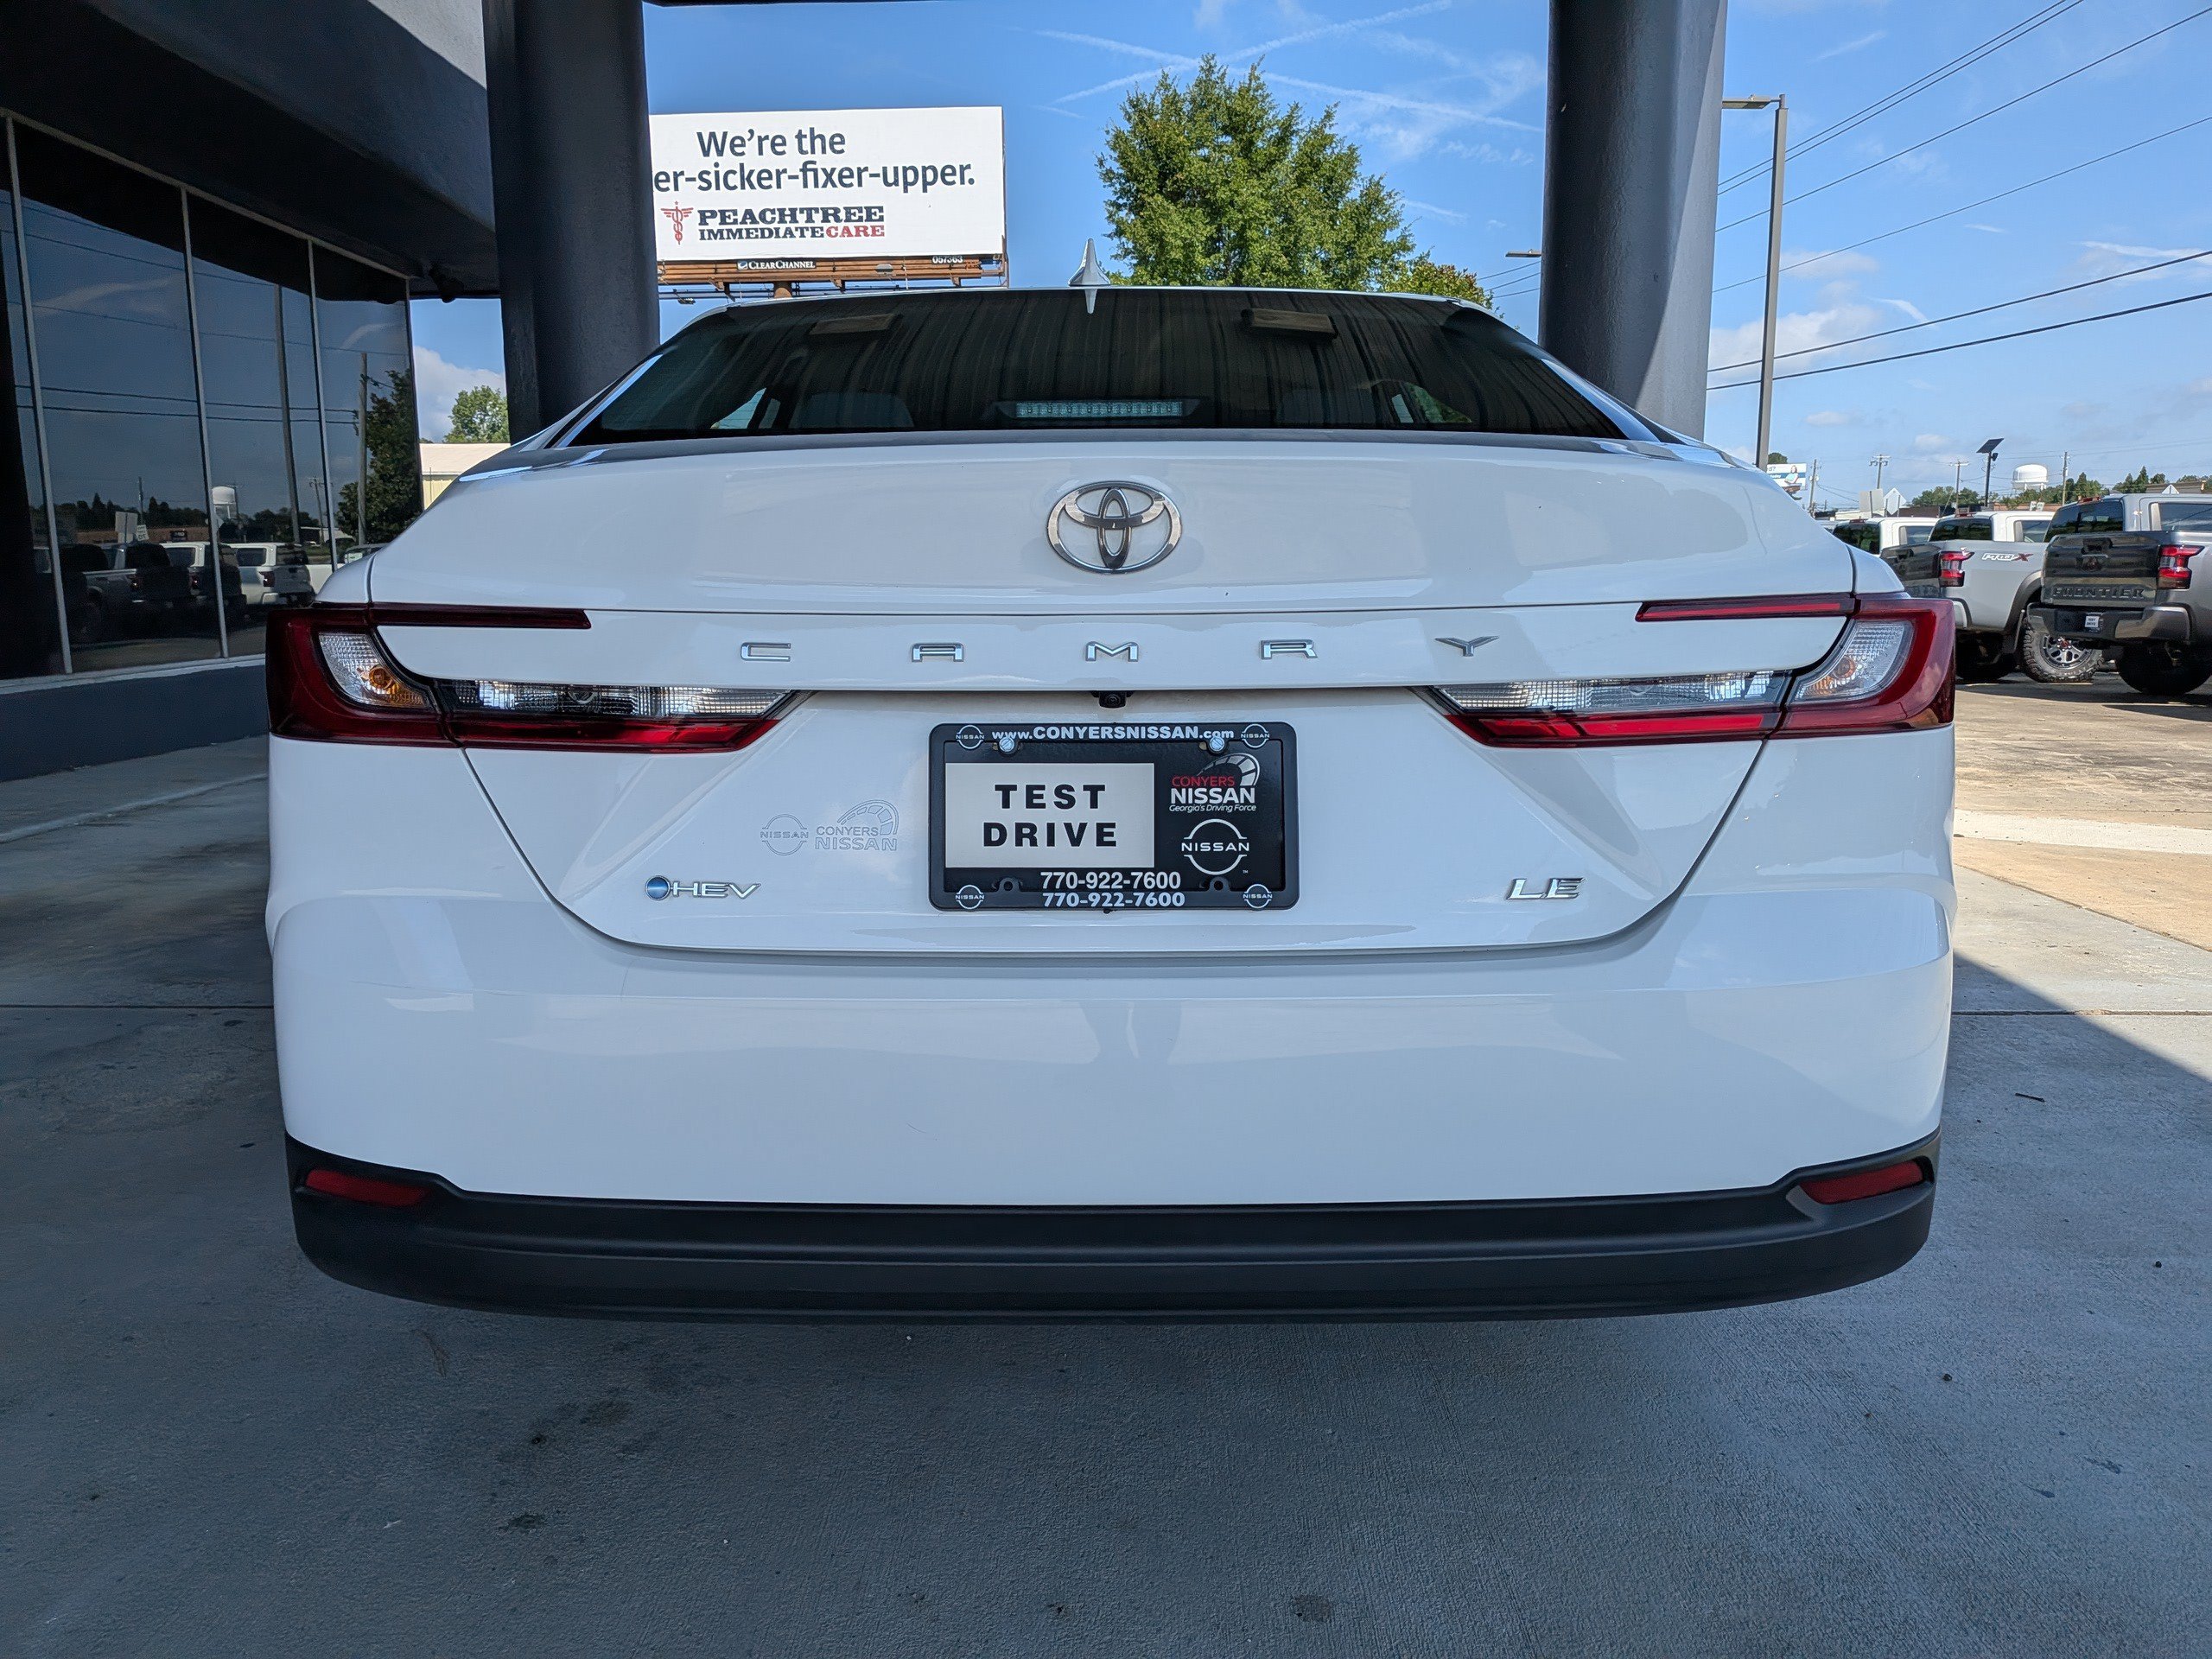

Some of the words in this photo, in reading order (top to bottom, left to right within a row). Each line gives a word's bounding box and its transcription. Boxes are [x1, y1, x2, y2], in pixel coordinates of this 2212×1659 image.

[696, 128, 787, 157] We’re
[795, 127, 846, 155] the
[697, 206, 885, 226] PEACHTREE
[2052, 587, 2145, 600] FRONTIER
[741, 635, 1500, 663] CAMRY
[992, 726, 1235, 740] www.CONYERSNISSAN.com
[1172, 776, 1236, 787] CONYERS
[995, 784, 1106, 810] TEST
[1170, 788, 1255, 804] NISSAN
[1169, 804, 1205, 813] Georgia's
[1206, 804, 1234, 813] Driving
[816, 825, 879, 836] CONYERS
[982, 822, 1117, 848] DRIVE
[815, 836, 898, 851] NISSAN
[1181, 842, 1249, 852] NISSAN
[1040, 871, 1181, 889] 770-922-7600
[1506, 877, 1586, 899] LE
[672, 880, 761, 899] HEV
[1042, 892, 1185, 907] 770-922-7600
